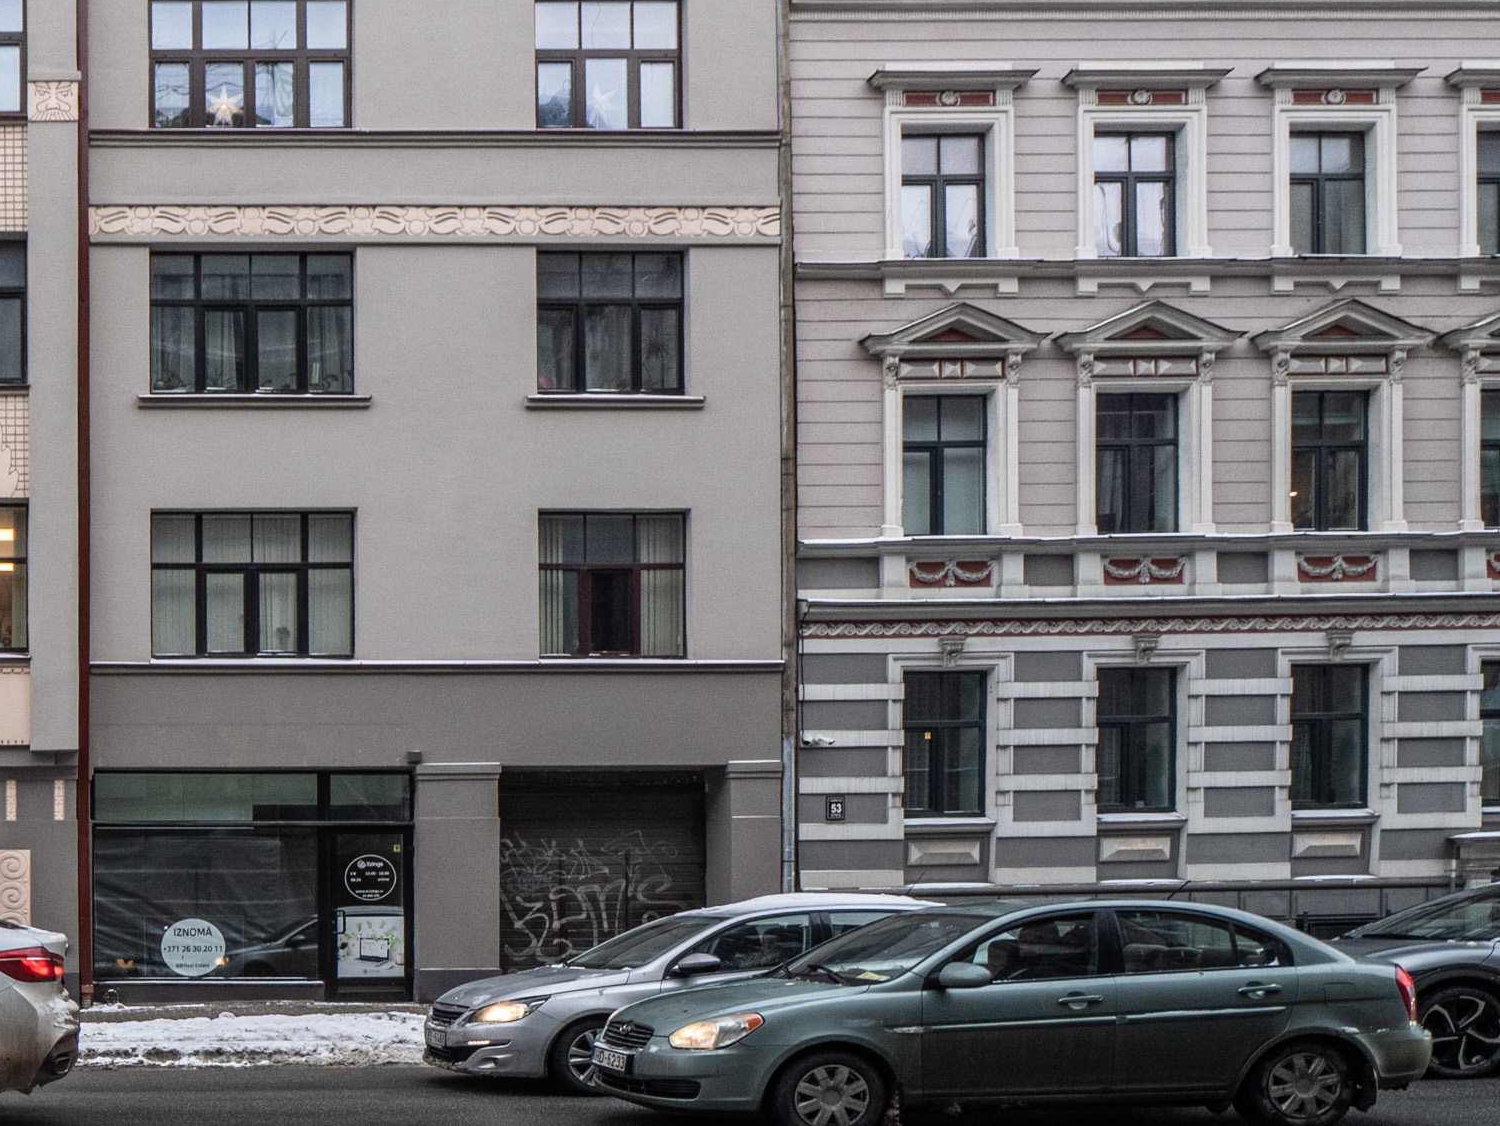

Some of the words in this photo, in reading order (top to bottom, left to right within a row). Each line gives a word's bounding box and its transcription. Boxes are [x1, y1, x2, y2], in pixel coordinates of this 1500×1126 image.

[830, 803, 842, 814] 53
[173, 927, 213, 937] IZNOMĀ
[181, 945, 191, 953] 26
[192, 945, 202, 953] 30
[203, 945, 213, 953] 20
[214, 945, 223, 953] 11
